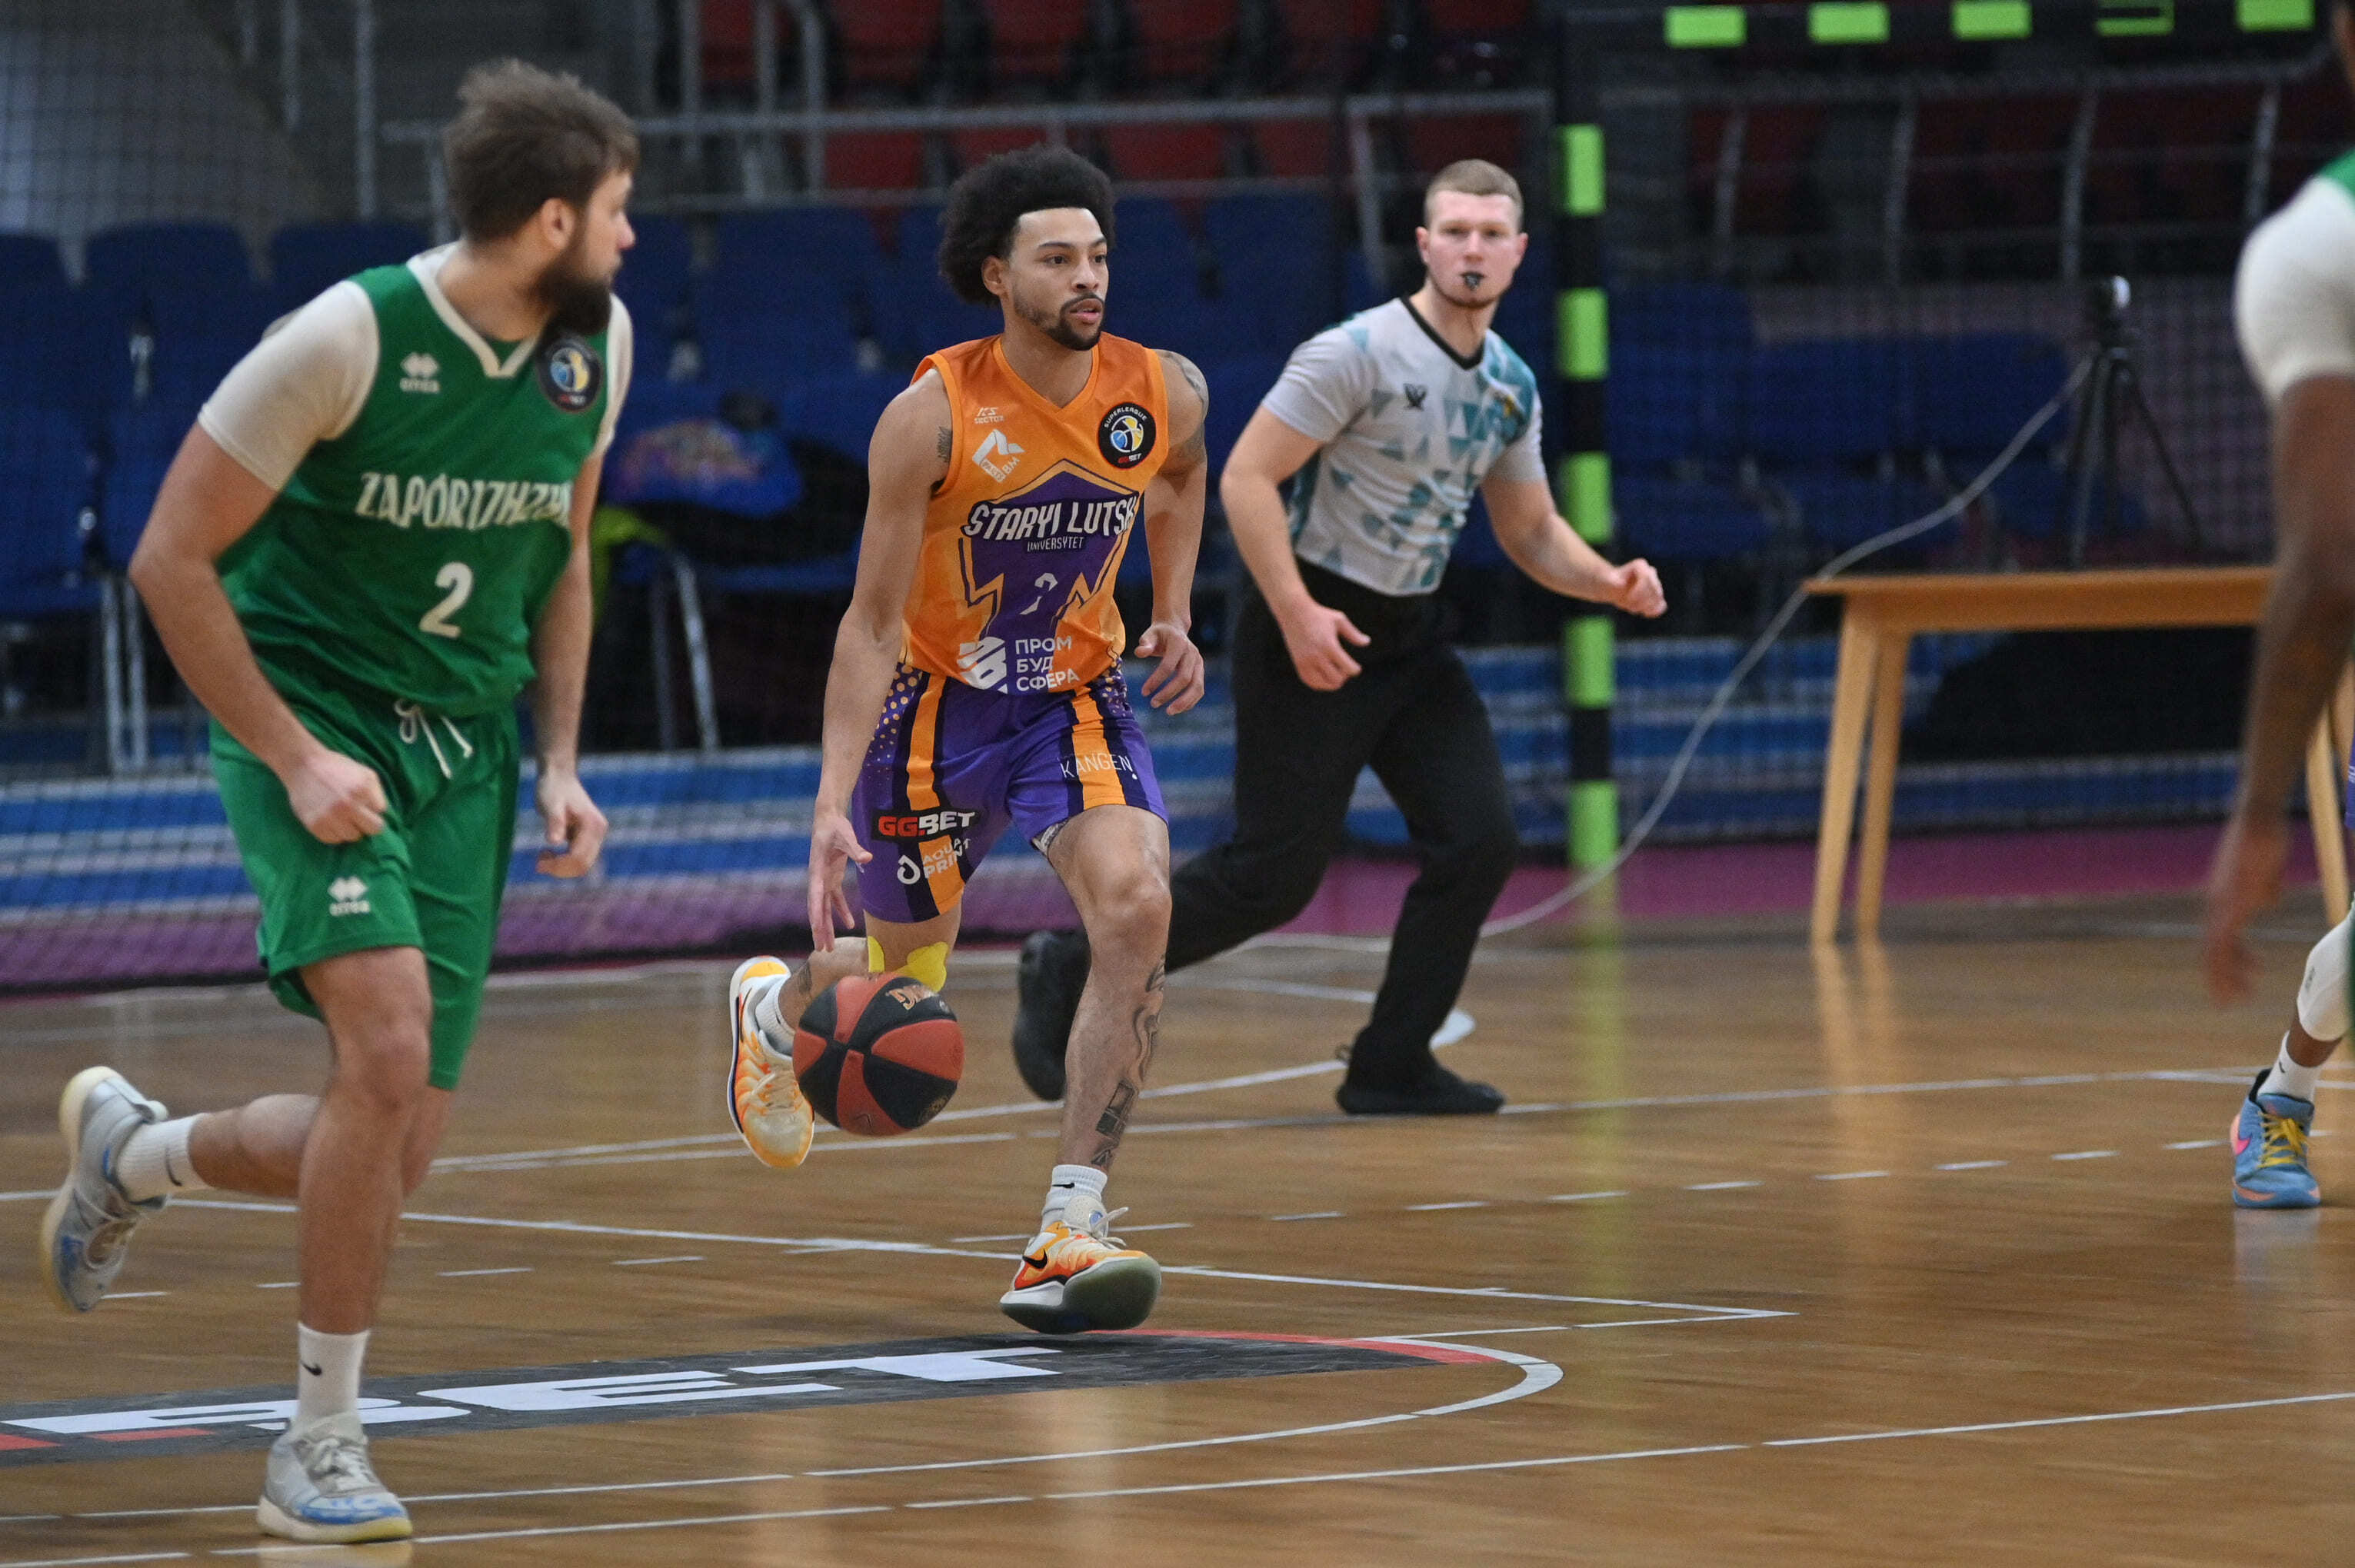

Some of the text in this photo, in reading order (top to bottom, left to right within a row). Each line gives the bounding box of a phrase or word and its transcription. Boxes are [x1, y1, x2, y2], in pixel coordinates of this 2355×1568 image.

[1104, 406, 1148, 428] SUPERLEAGUE
[964, 495, 1138, 540] STARYI LUTSK
[1027, 535, 1084, 552] UNIVERSYTET
[418, 561, 475, 639] 2
[1015, 635, 1073, 655] ПРОМ
[1016, 655, 1054, 674] БУД
[1015, 667, 1081, 692] СФЕРА
